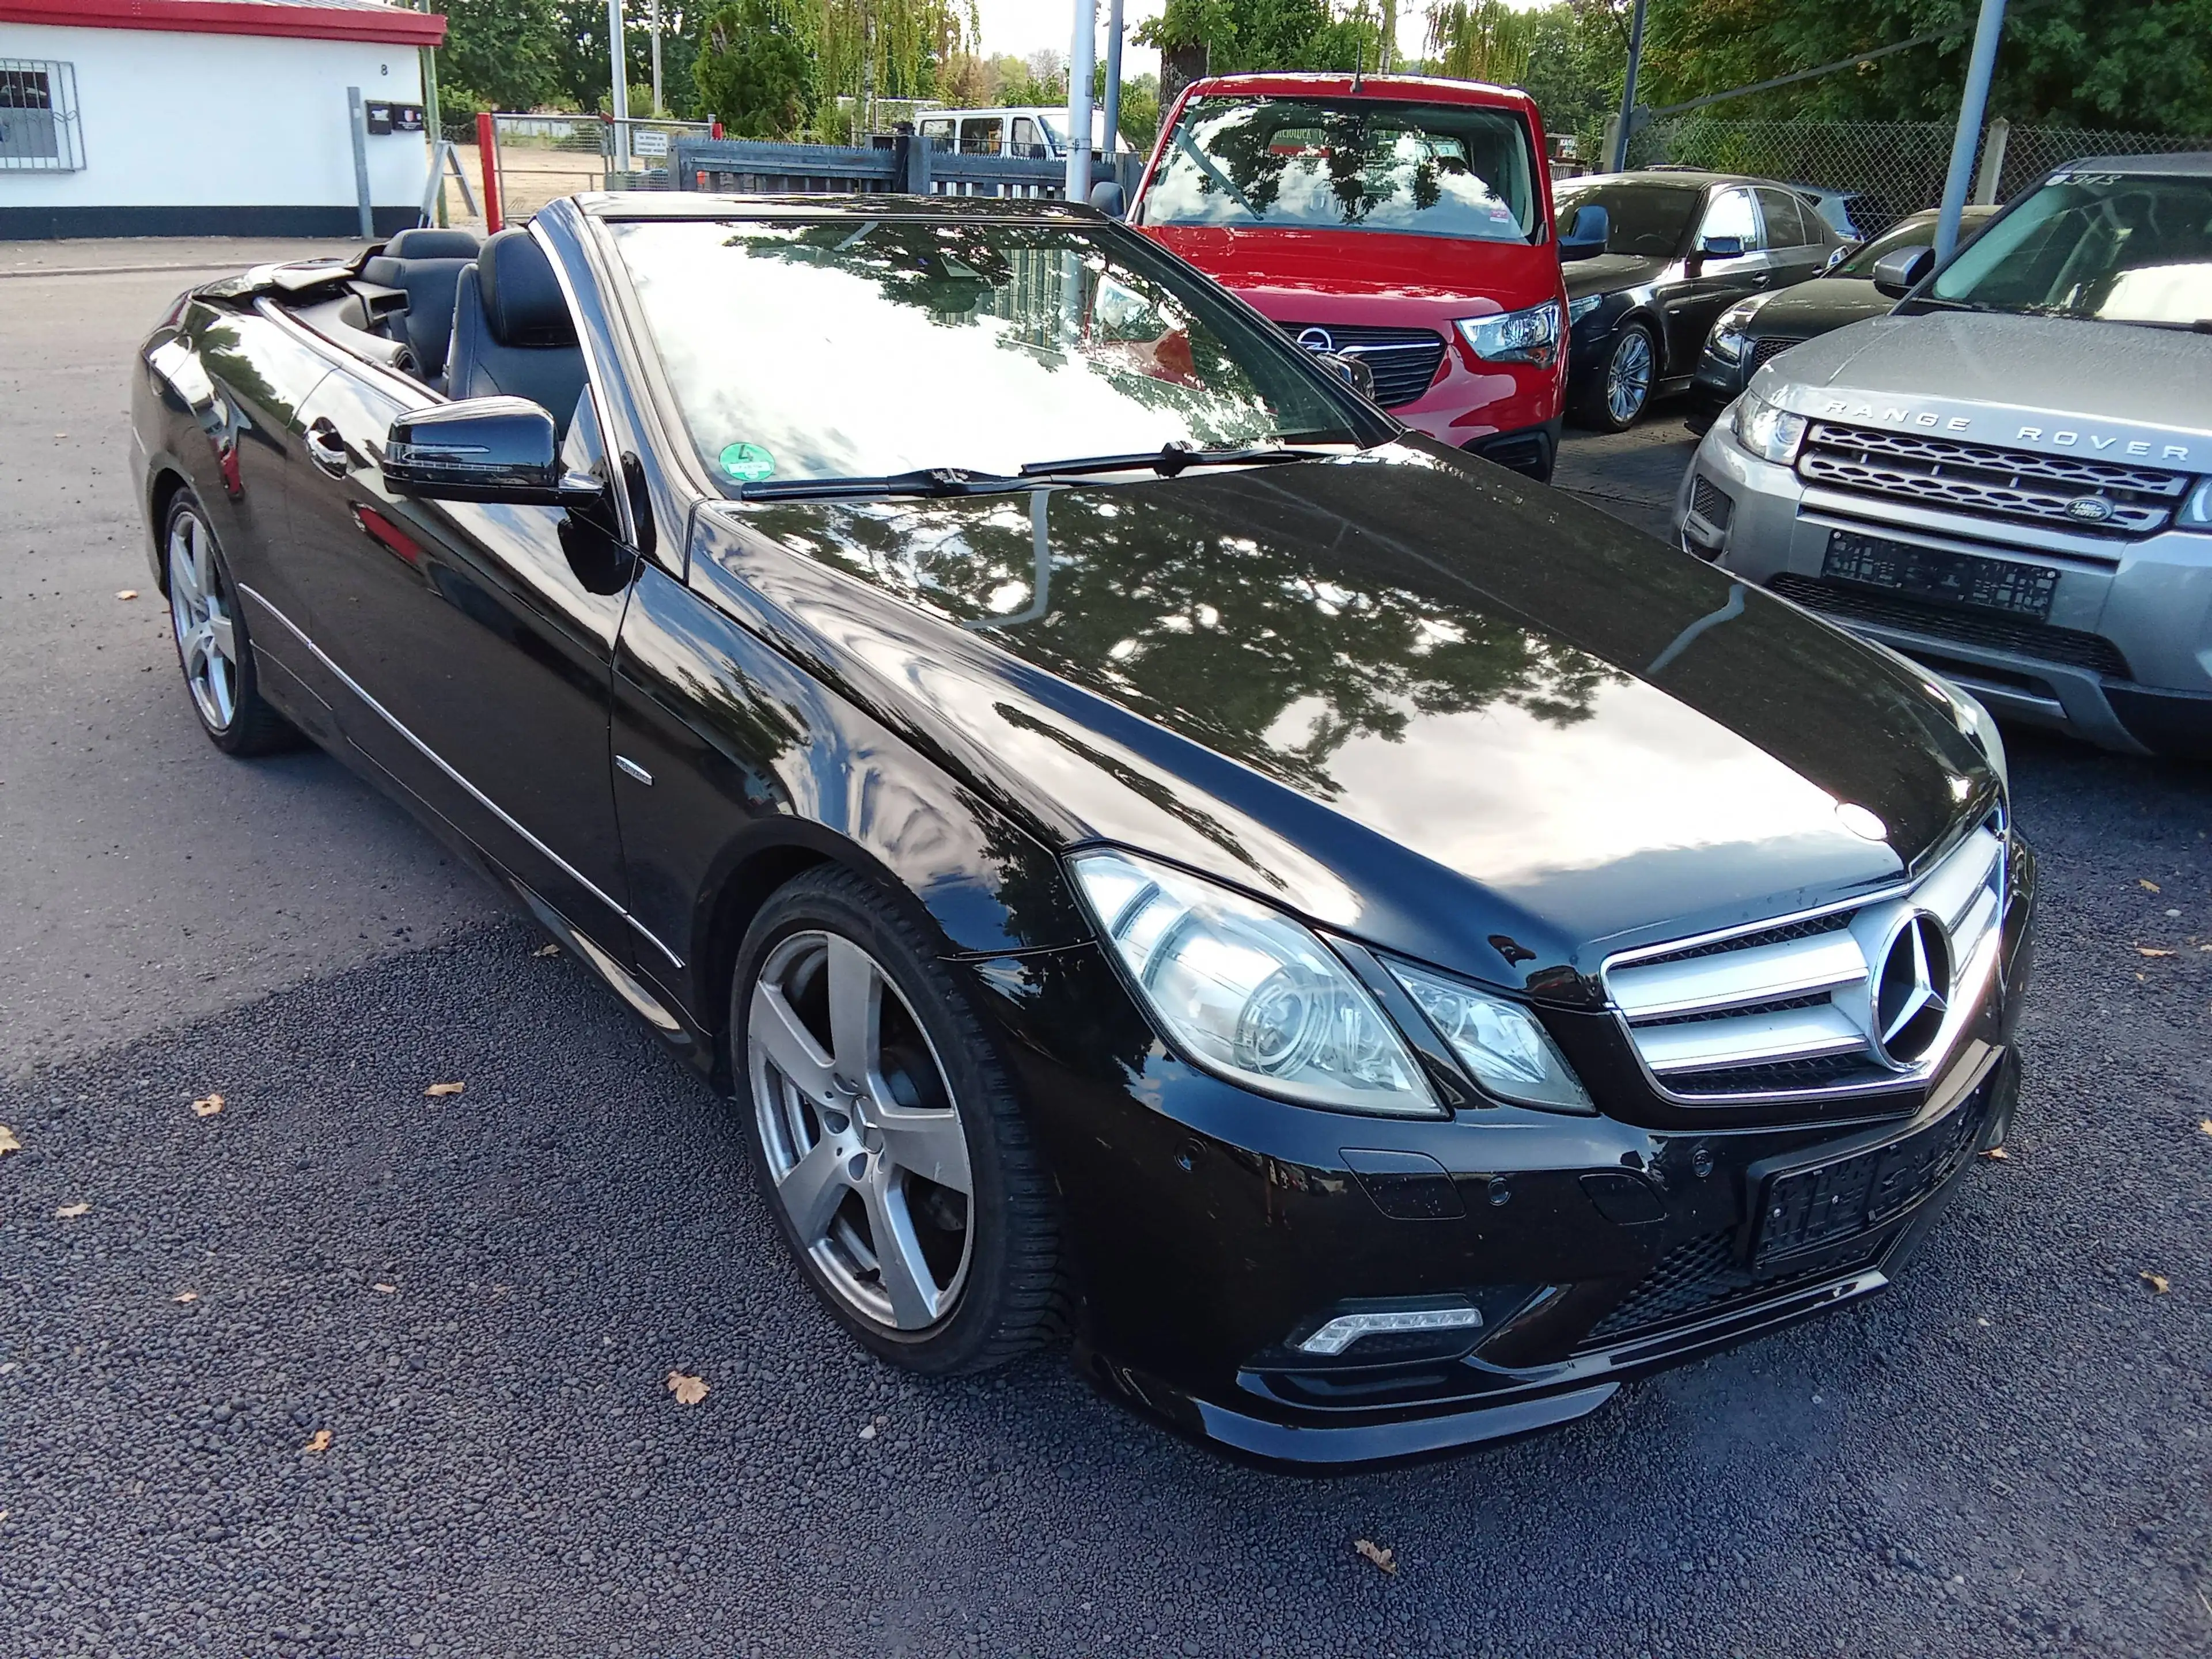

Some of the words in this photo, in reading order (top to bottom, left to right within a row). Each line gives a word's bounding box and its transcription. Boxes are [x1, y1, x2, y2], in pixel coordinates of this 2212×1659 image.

[381, 64, 388, 75] 8
[1825, 400, 1971, 432] RANGE
[2017, 426, 2190, 461] ROVER
[738, 445, 753, 461] 4
[2074, 509, 2102, 517] ROVER
